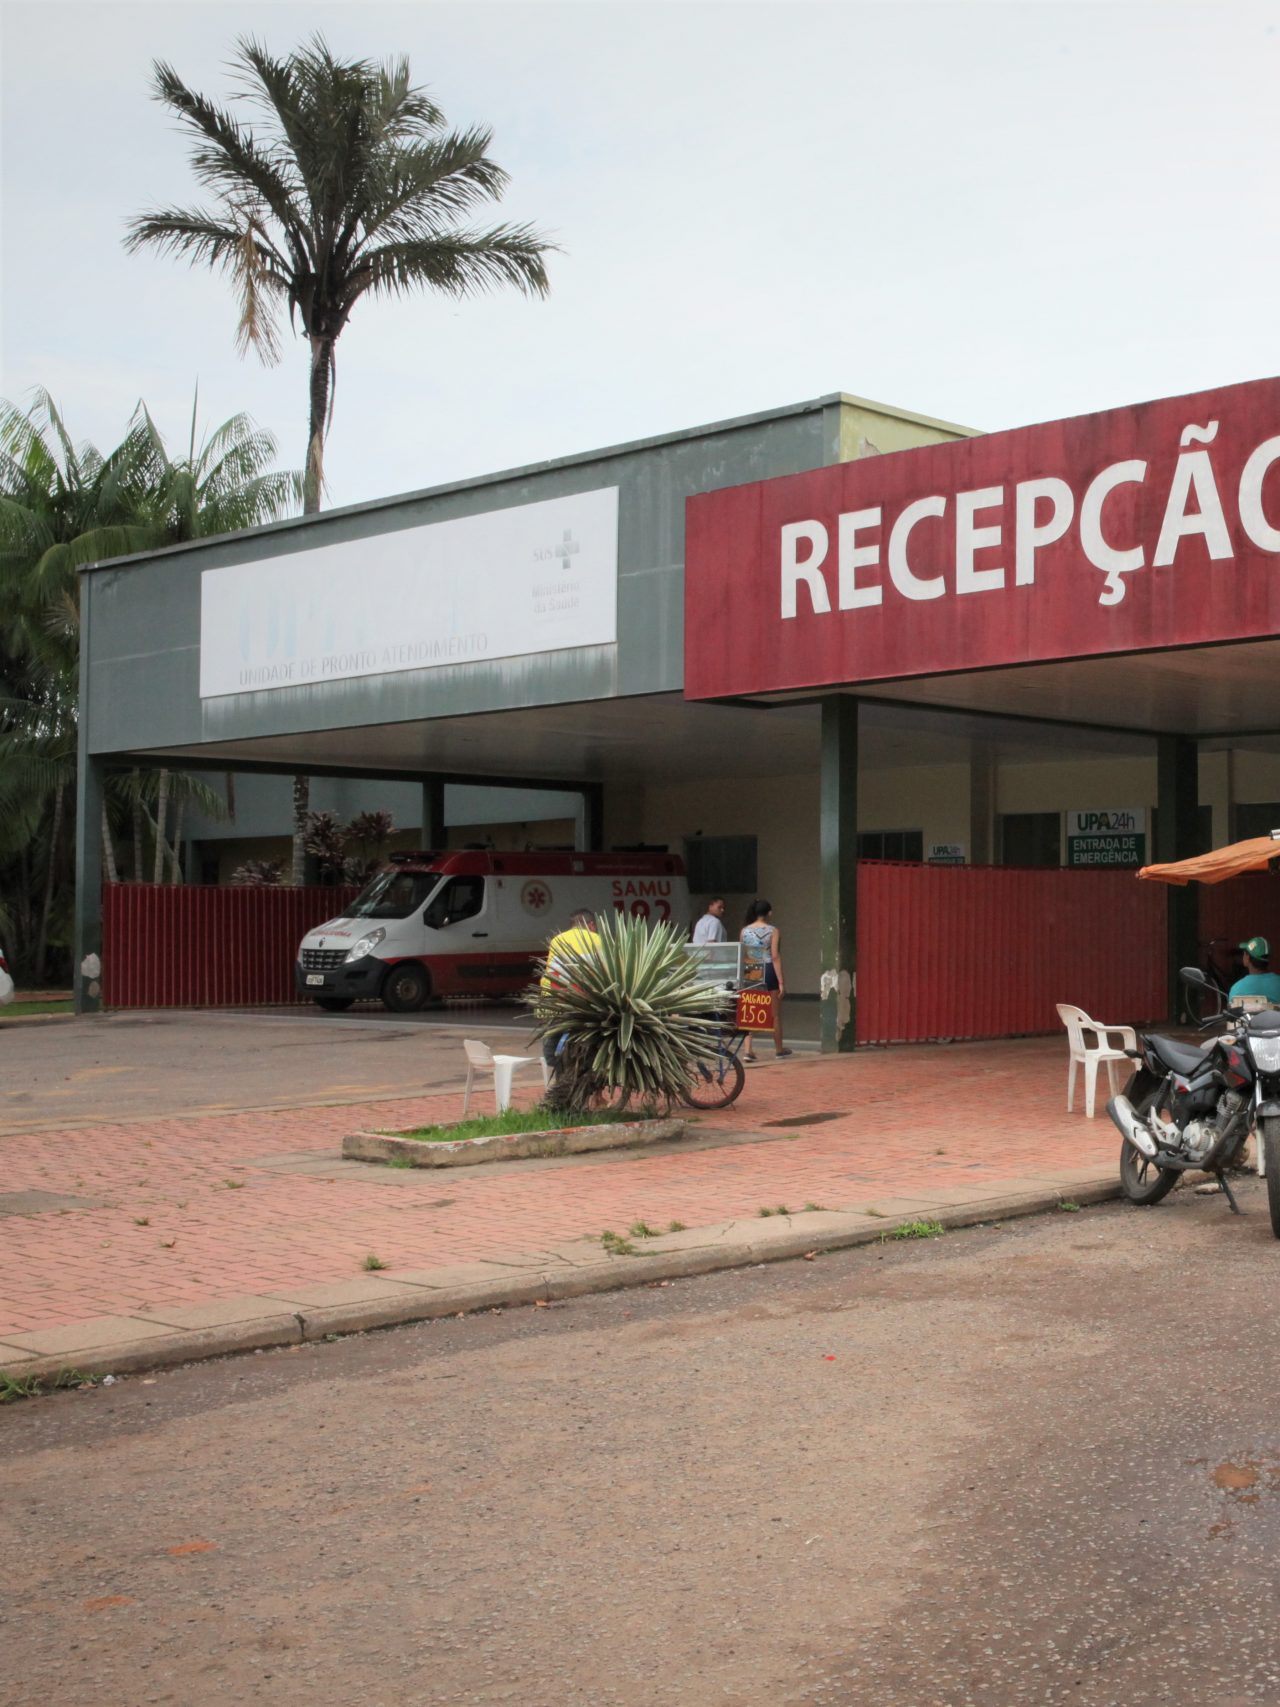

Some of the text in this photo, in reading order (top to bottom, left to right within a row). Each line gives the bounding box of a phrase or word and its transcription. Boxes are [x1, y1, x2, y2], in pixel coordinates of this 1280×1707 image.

[239, 662, 295, 685] UNIDADE
[322, 651, 376, 674] PRONTO
[382, 633, 488, 665] ATENDIMENTO
[1073, 837, 1136, 850] ENTRADA DE
[1073, 849, 1138, 864] EMERGÊNCIA
[612, 880, 672, 897] SAMU
[741, 992, 772, 1005] SALGADO
